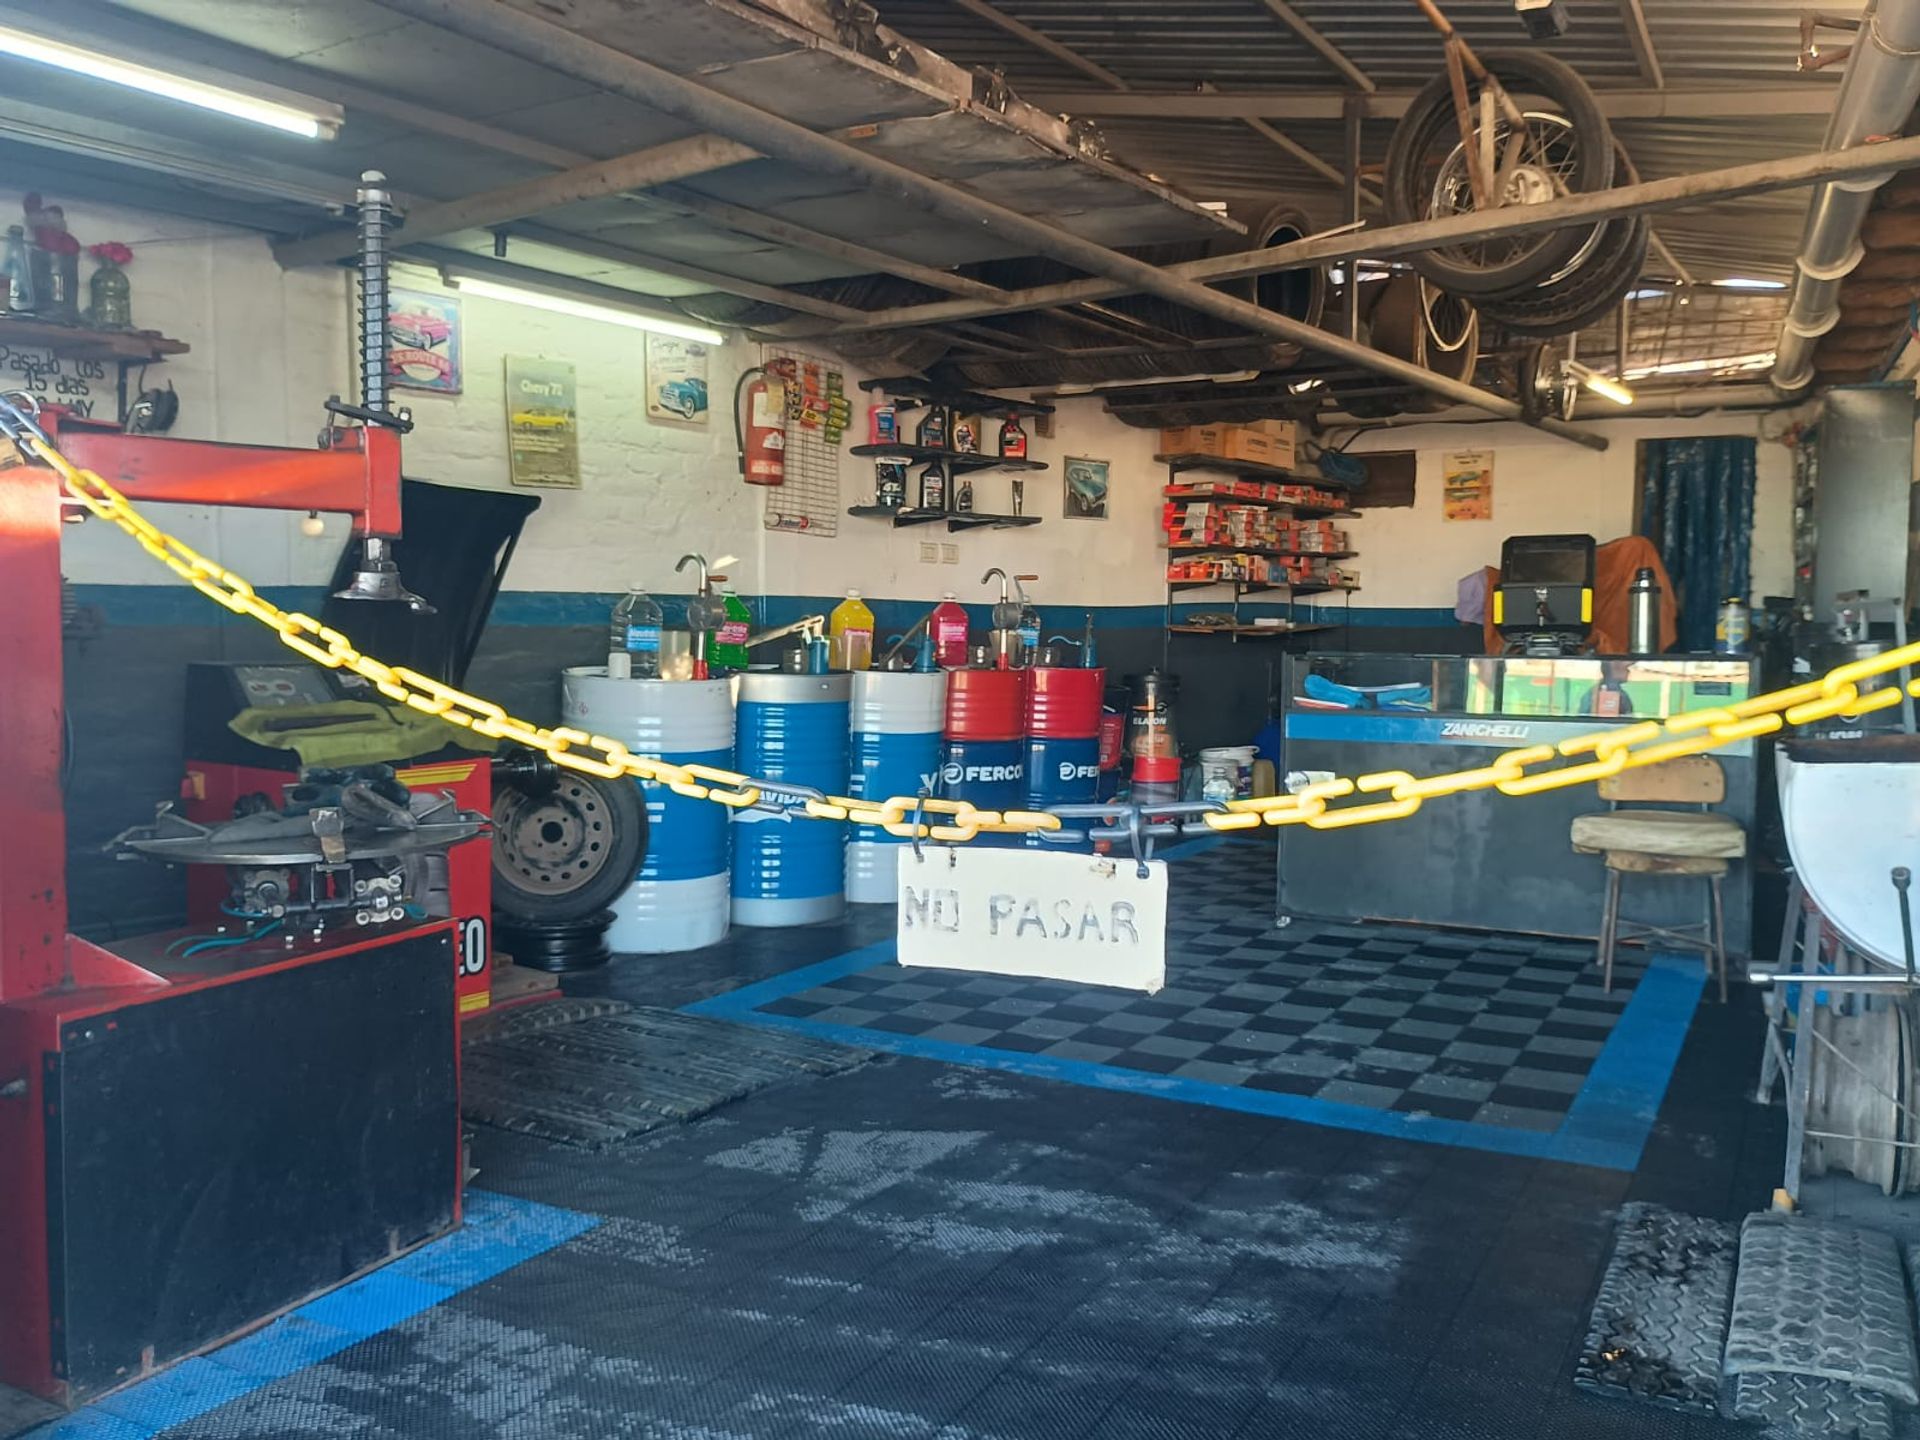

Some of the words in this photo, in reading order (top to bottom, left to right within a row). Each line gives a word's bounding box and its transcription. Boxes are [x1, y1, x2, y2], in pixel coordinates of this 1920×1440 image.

[24, 367, 48, 391] 15
[1132, 717, 1168, 726] ELAON
[1441, 722, 1530, 739] ZANICHELLI
[904, 885, 960, 933] NO
[989, 893, 1139, 945] PASAR
